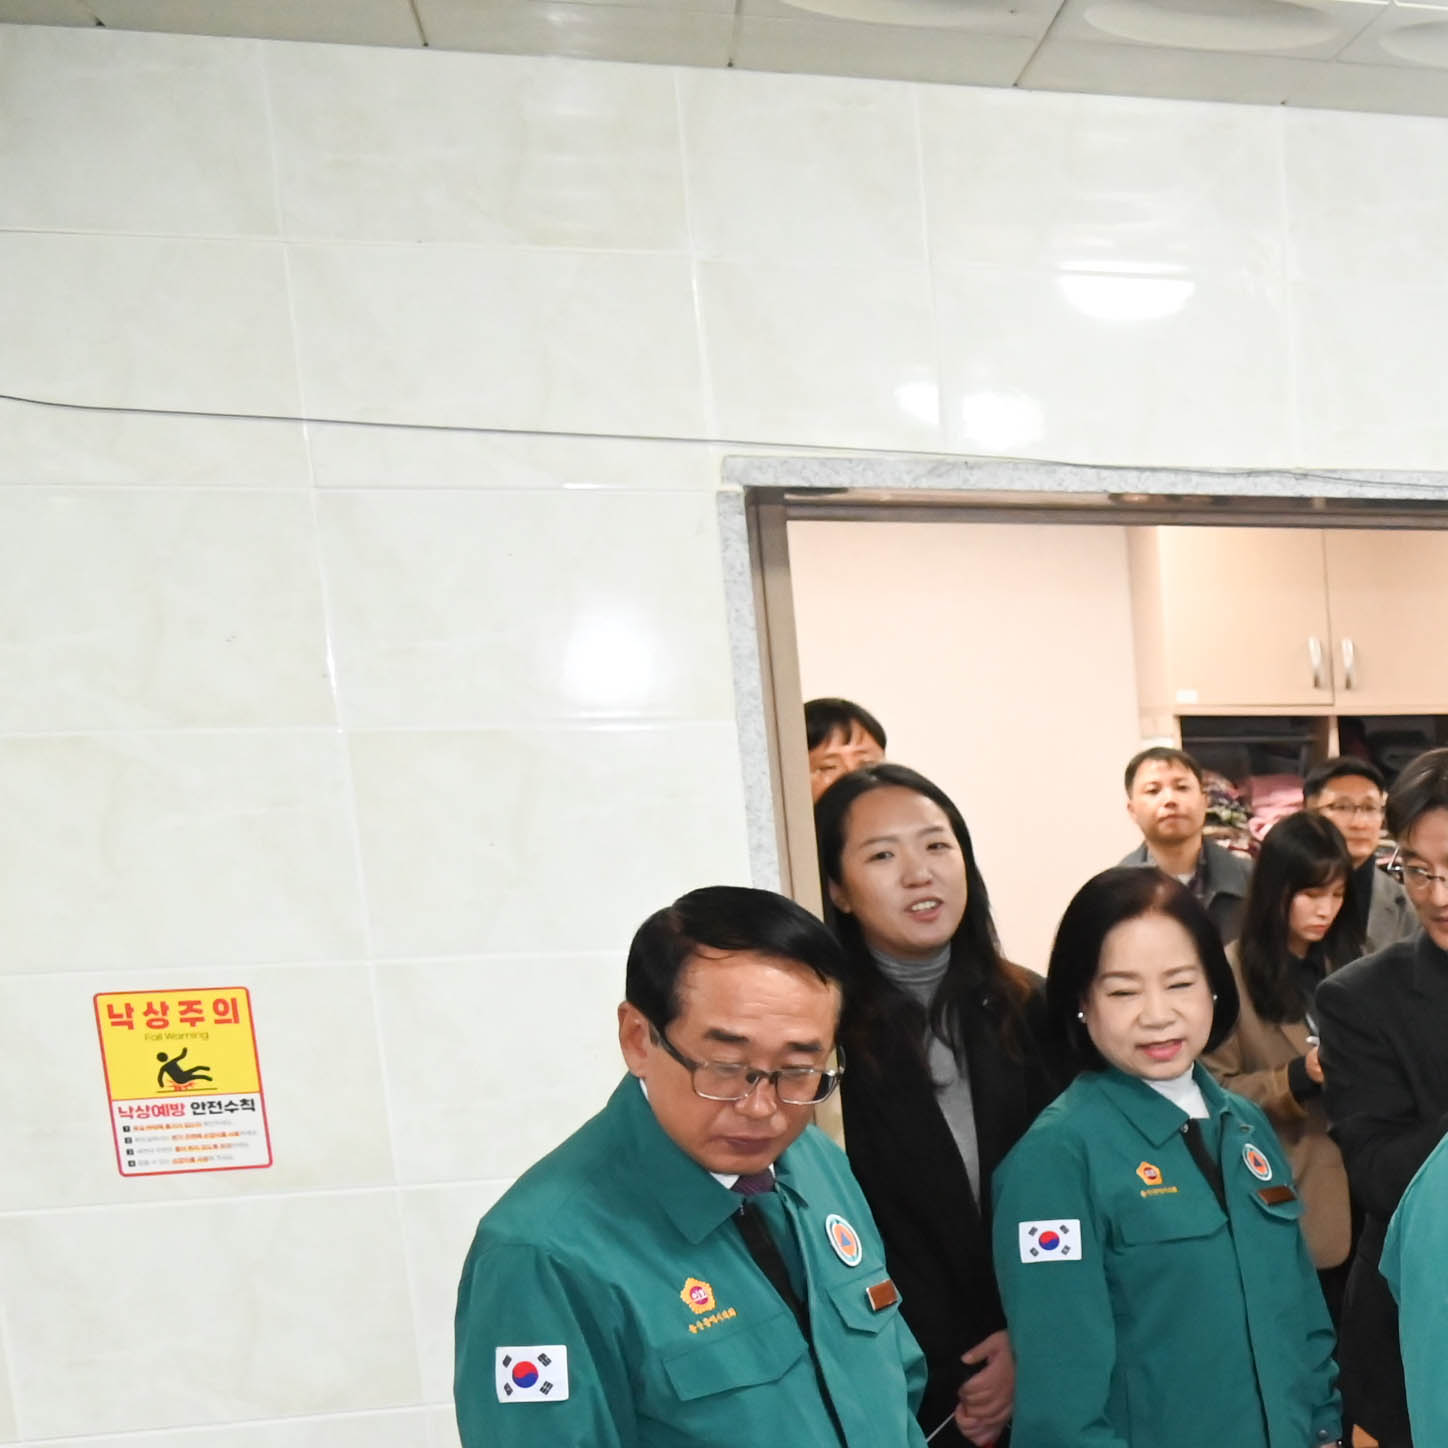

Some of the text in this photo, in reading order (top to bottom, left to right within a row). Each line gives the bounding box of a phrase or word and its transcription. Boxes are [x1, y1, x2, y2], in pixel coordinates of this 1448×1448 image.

[106, 997, 240, 1031] 낙상주의
[118, 1098, 256, 1119] 낙상예방 안전수칙
